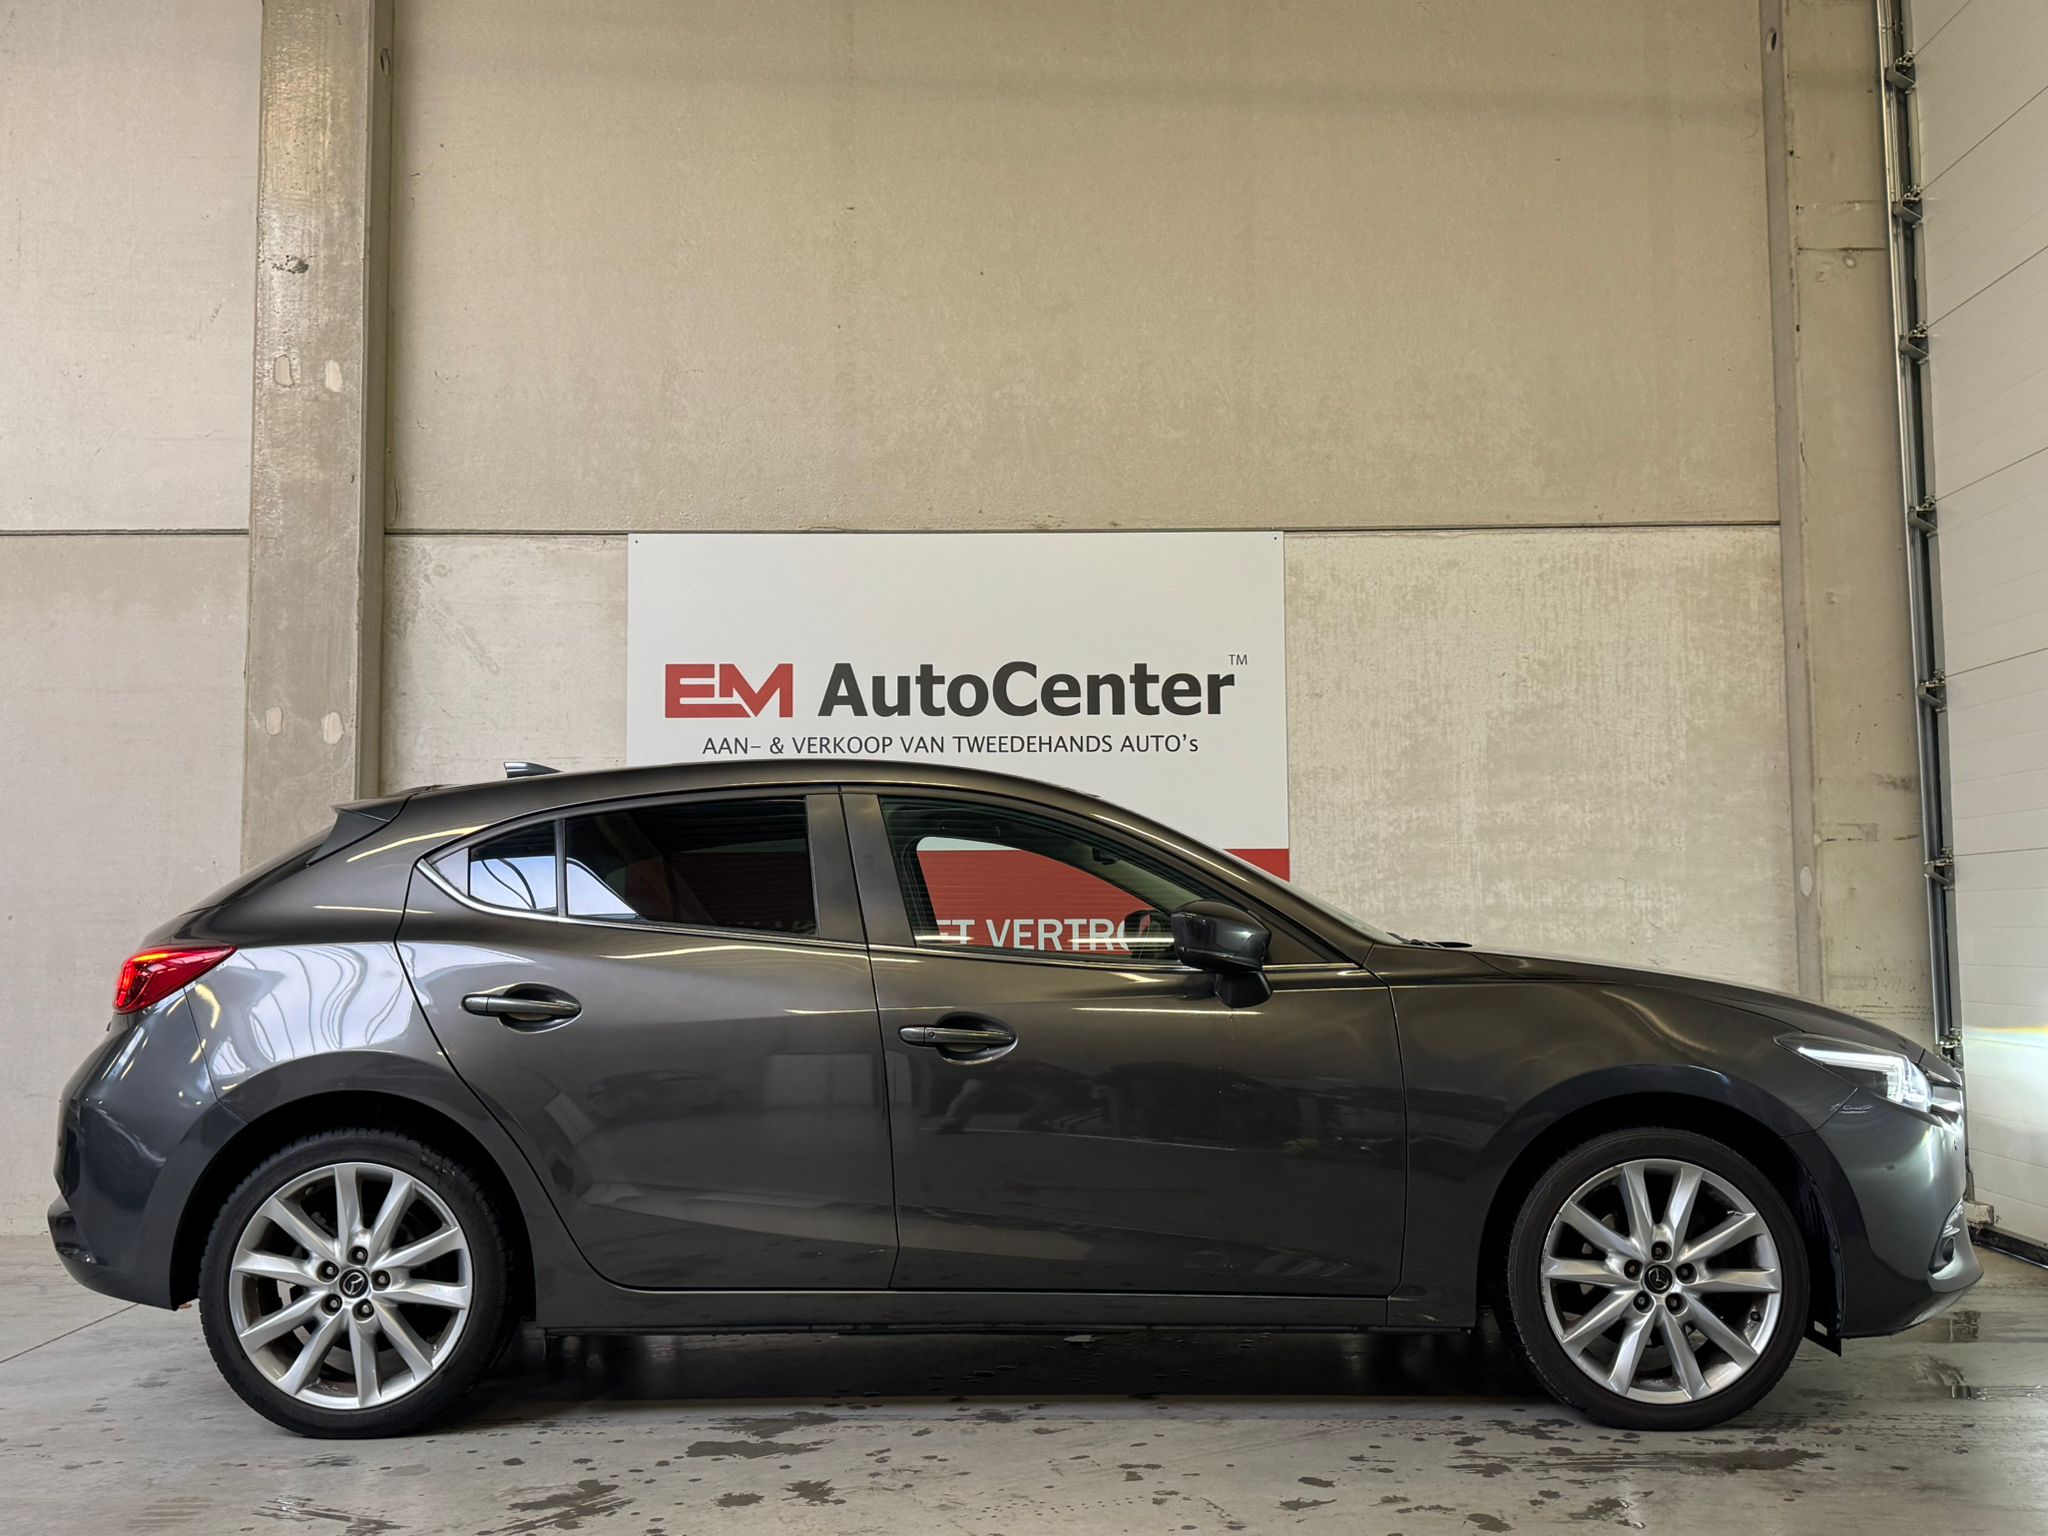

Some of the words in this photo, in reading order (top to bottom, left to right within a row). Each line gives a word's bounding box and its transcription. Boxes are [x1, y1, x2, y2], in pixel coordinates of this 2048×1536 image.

[665, 663, 793, 718] EM
[817, 661, 1235, 716] AutoCenter
[769, 737, 785, 754] &
[792, 736, 893, 754] VERKOOP
[900, 736, 944, 754] VAN
[952, 735, 1112, 753] TWEEDEHANDS
